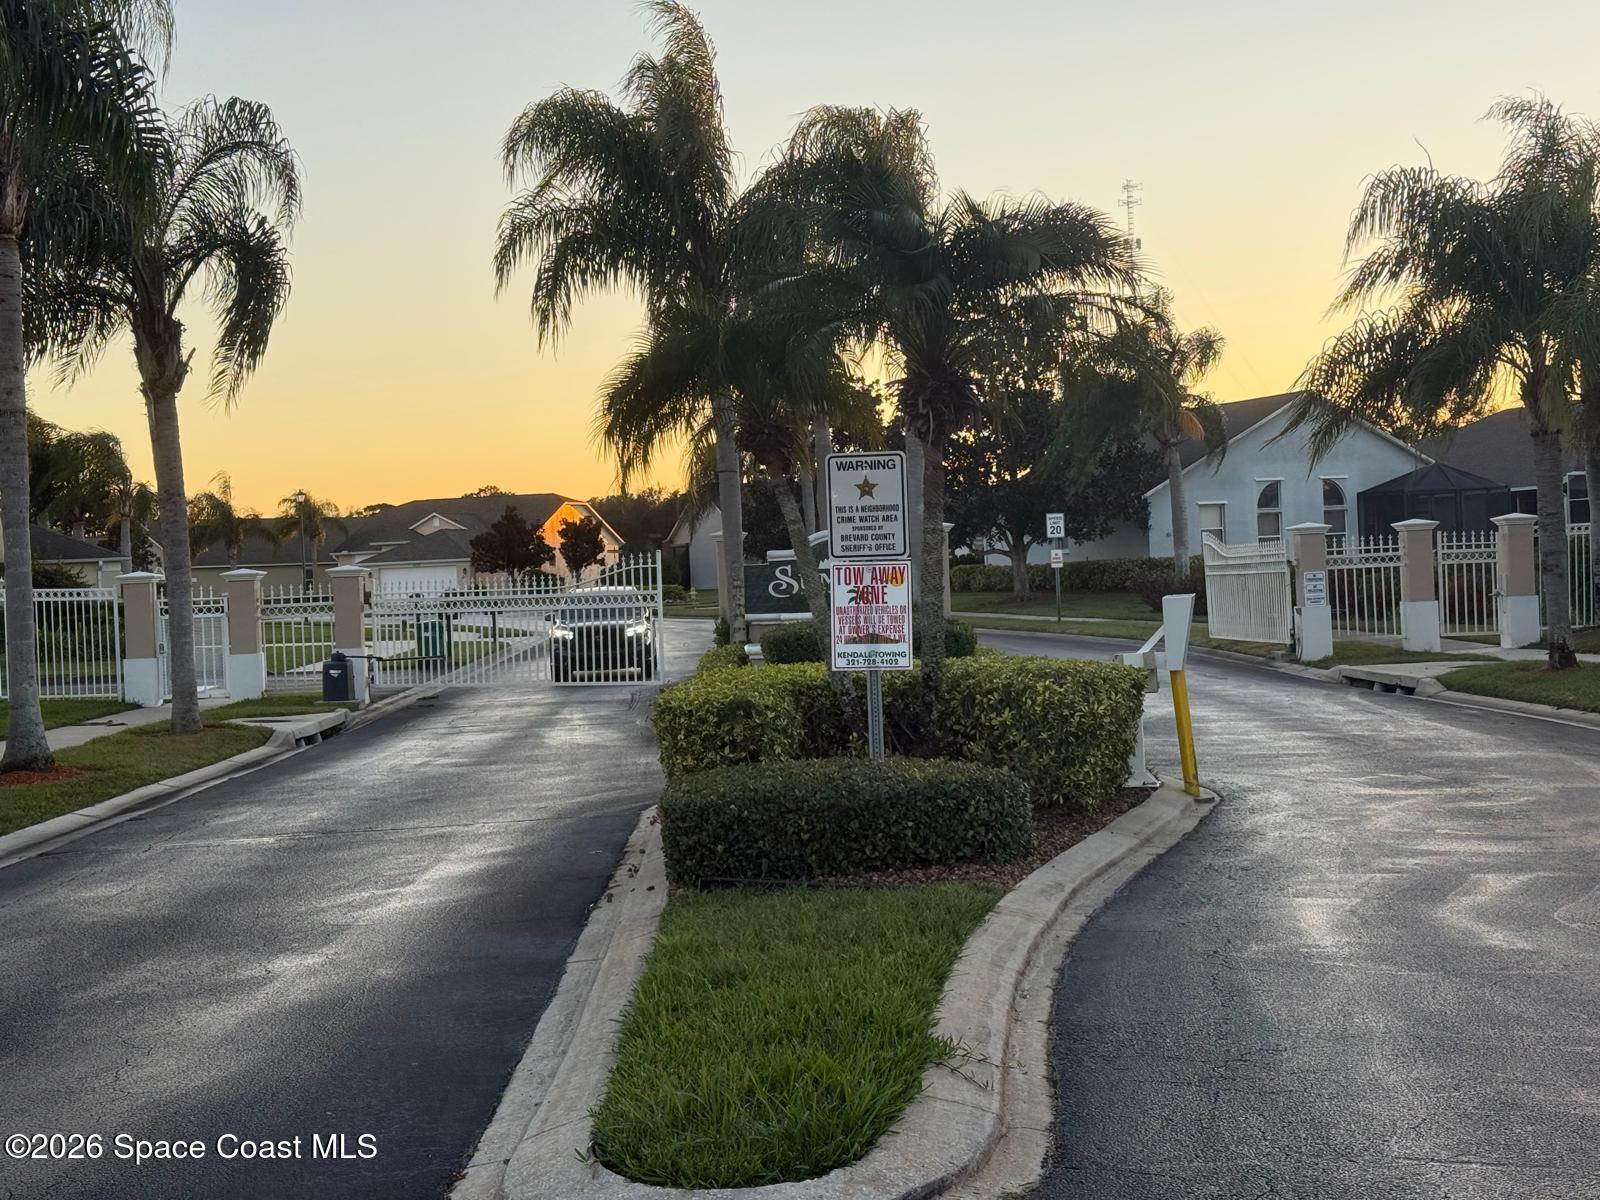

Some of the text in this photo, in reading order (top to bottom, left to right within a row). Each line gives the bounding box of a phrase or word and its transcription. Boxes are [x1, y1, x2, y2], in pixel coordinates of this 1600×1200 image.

[835, 459, 896, 471] WARNING
[848, 505, 854, 513] IS
[860, 504, 900, 512] NEIGHBORHOOD
[836, 516, 856, 524] CRIME
[858, 515, 880, 523] WATCH
[1050, 526, 1062, 534] 20
[840, 532, 896, 542] BREVARD COUNTY
[840, 543, 896, 552] SHERIFF'S OFFICE
[835, 566, 906, 586] TOW AWAY
[853, 586, 888, 604] ZONE
[874, 605, 898, 614] VEHICLES
[900, 604, 906, 614] OR
[862, 616, 876, 624] WILL
[878, 615, 884, 624] BE
[887, 615, 906, 624] TOWED
[838, 625, 846, 634] AT
[878, 624, 904, 634] EXPENSE
